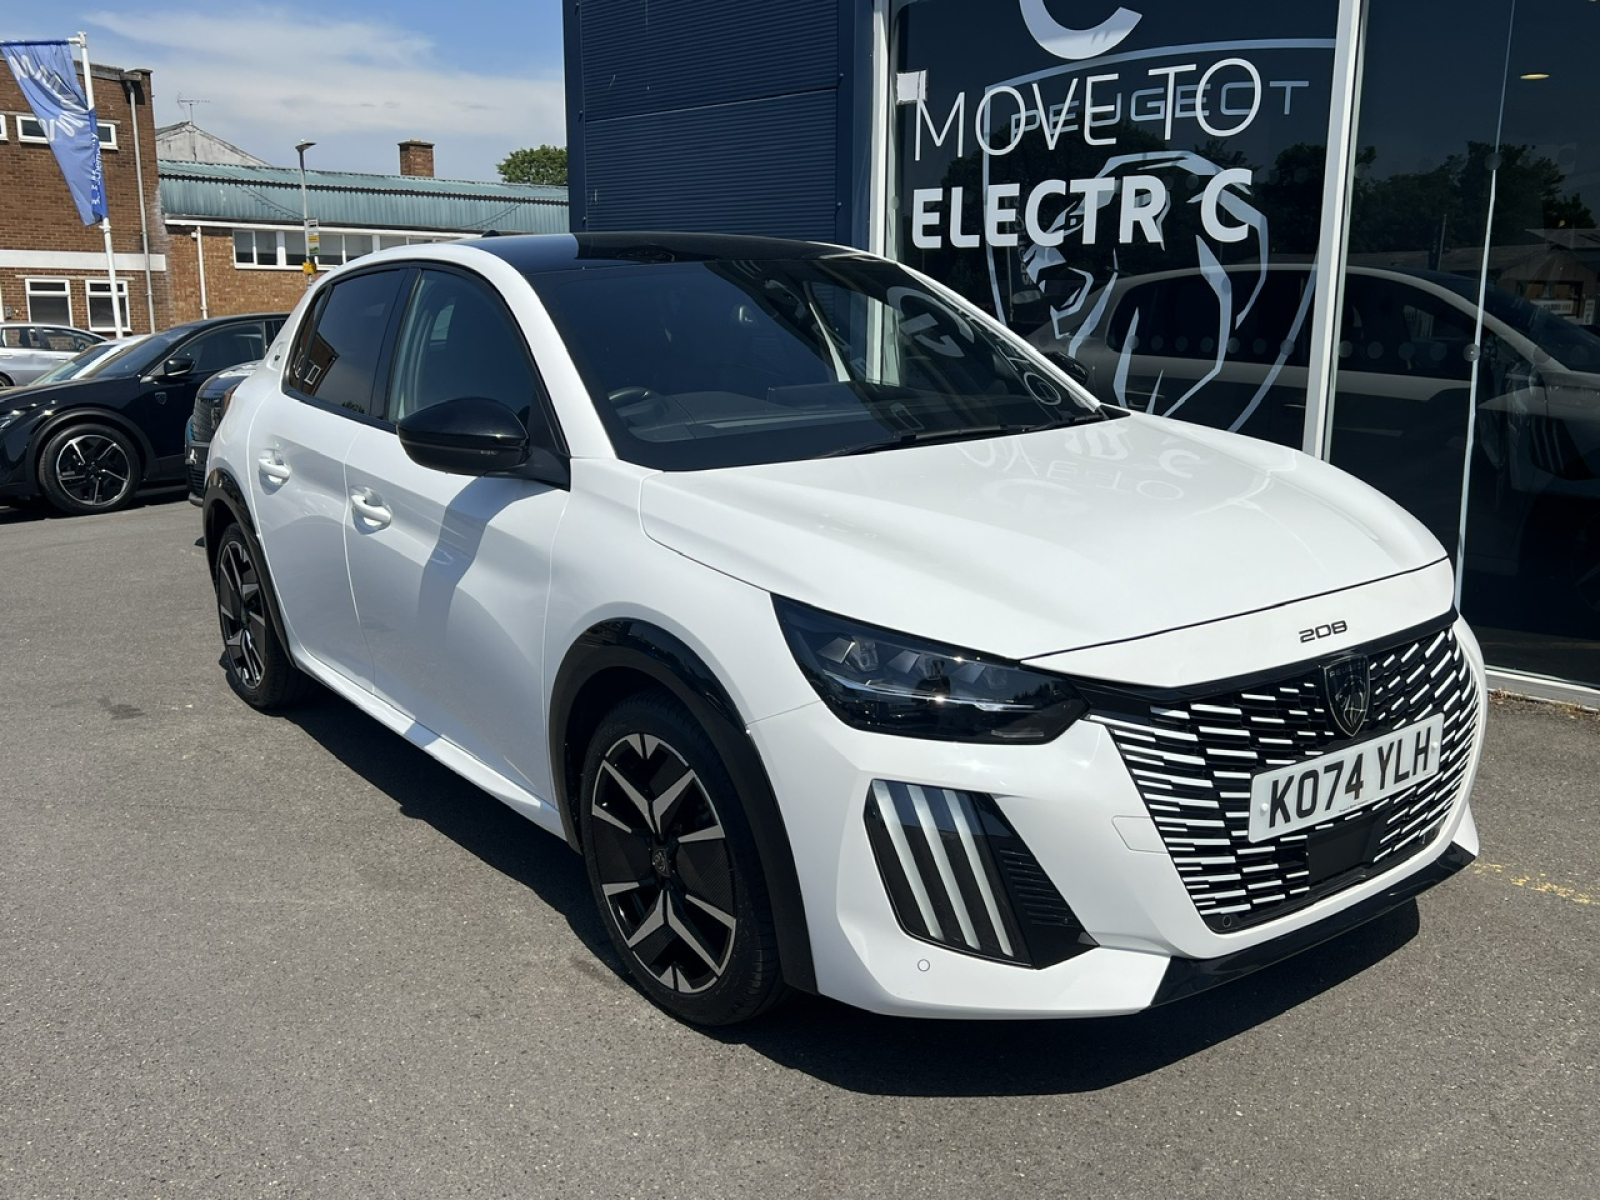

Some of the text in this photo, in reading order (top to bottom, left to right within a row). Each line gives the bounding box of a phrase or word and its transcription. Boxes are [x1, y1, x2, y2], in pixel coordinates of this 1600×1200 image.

[914, 58, 1262, 161] MOVE TO
[912, 168, 1253, 249] ELECTRC
[1299, 620, 1347, 643] 208
[1269, 726, 1432, 828] KO74 YLH
